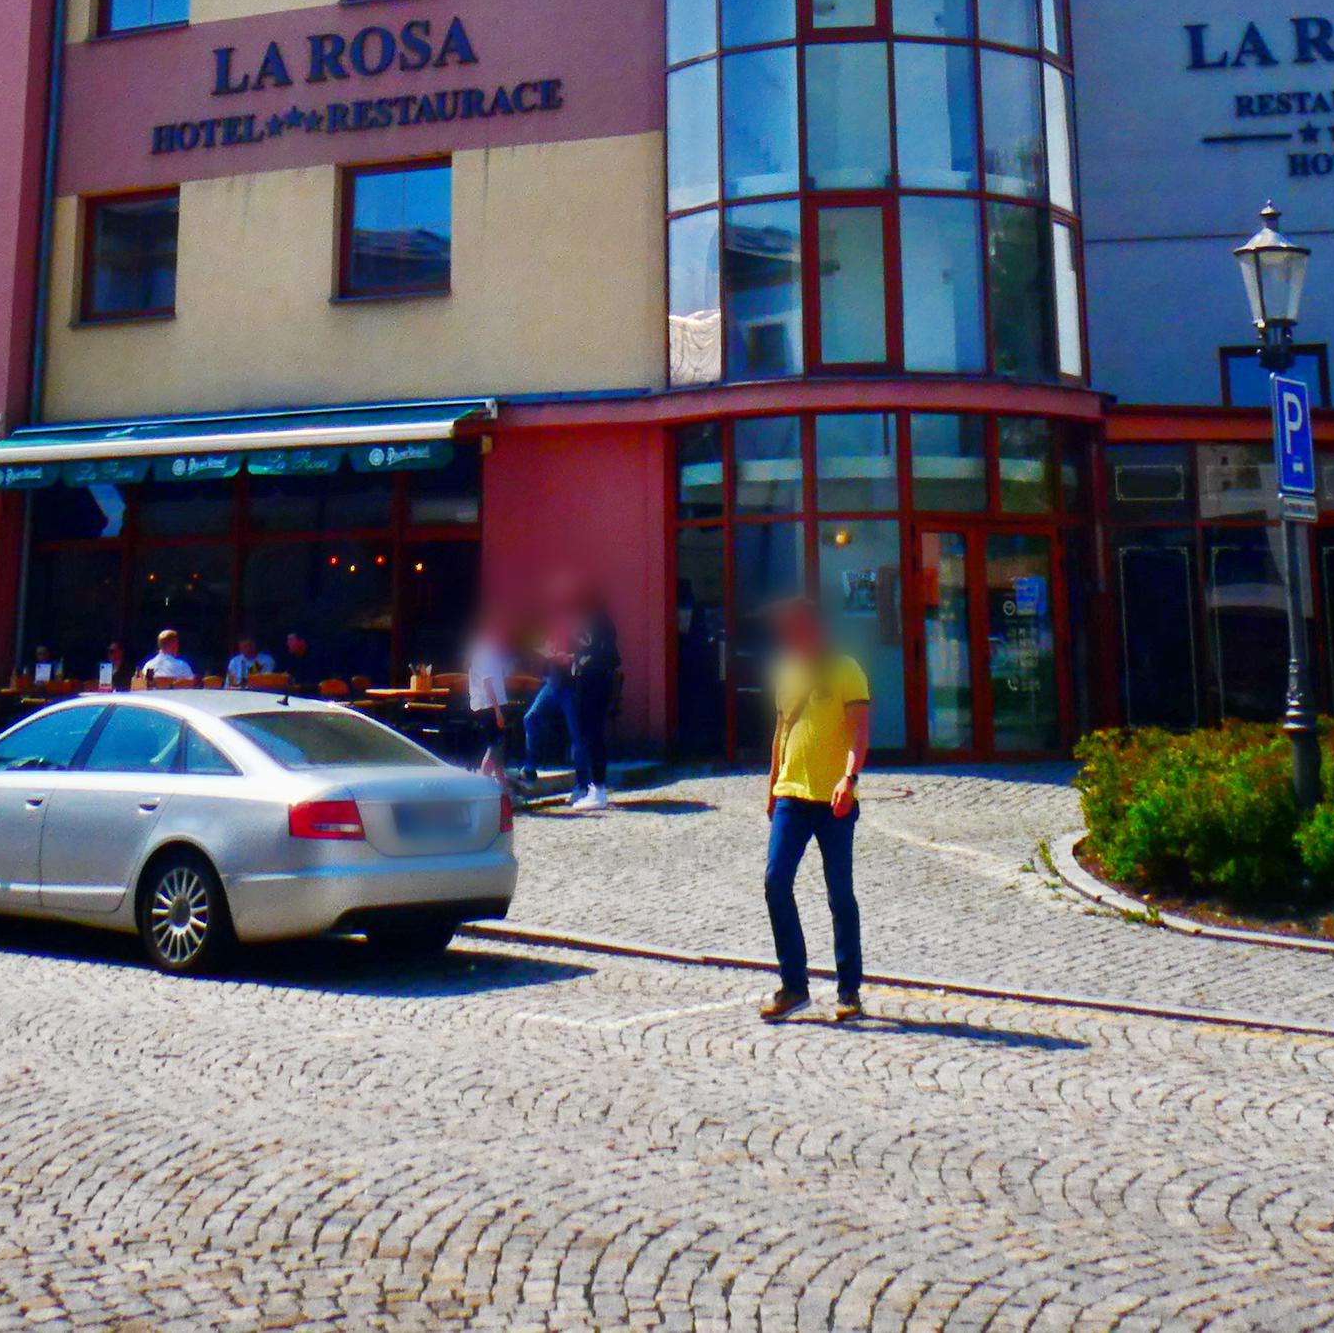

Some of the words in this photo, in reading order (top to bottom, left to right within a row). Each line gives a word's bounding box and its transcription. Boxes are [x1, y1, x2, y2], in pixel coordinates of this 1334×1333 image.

[210, 40, 293, 97] LA
[305, 16, 479, 84] ROSA
[1183, 20, 1279, 70] LA
[151, 113, 264, 155] HOTEL
[325, 79, 564, 134] RESTAURACE
[1282, 391, 1303, 455] P
